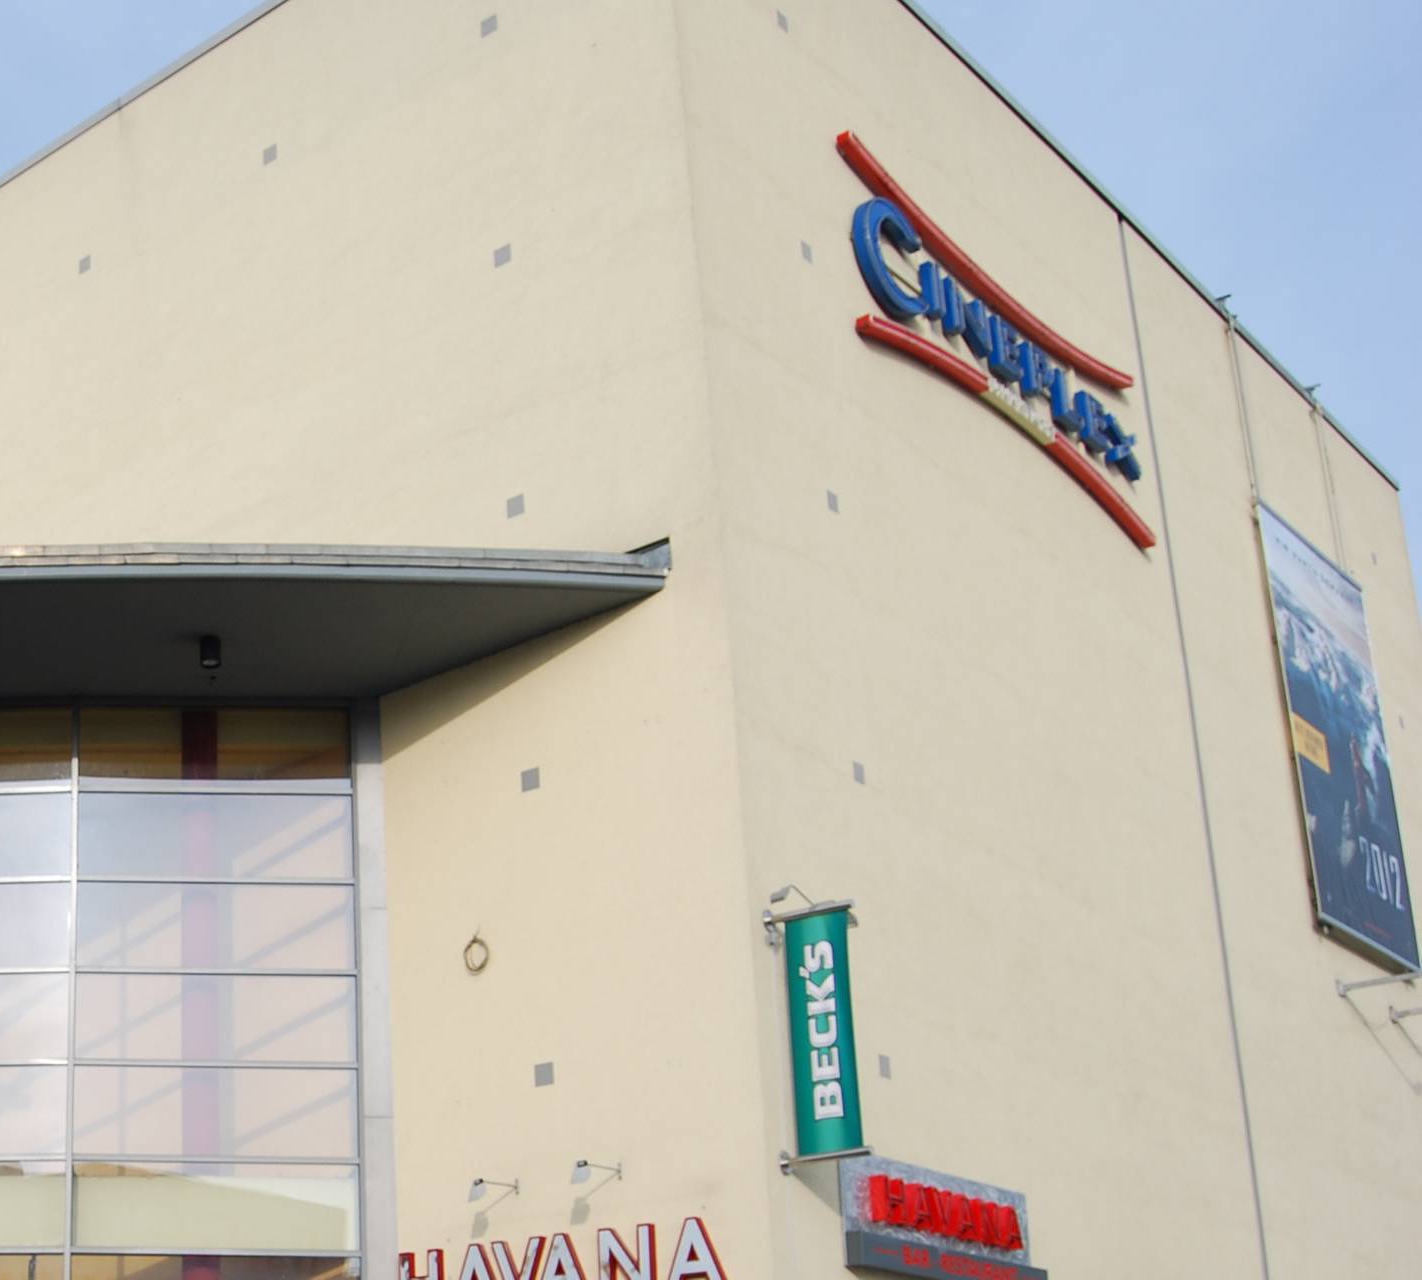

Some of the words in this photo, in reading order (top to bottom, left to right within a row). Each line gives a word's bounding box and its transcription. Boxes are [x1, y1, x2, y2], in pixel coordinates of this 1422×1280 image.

[851, 195, 1141, 482] CINEPLEX
[1358, 834, 1406, 912] 2012
[798, 939, 845, 1121] BECK'S
[868, 1173, 1025, 1252] HAVANA
[901, 1244, 930, 1269] BAR
[939, 1252, 1019, 1280] RESTAURANT
